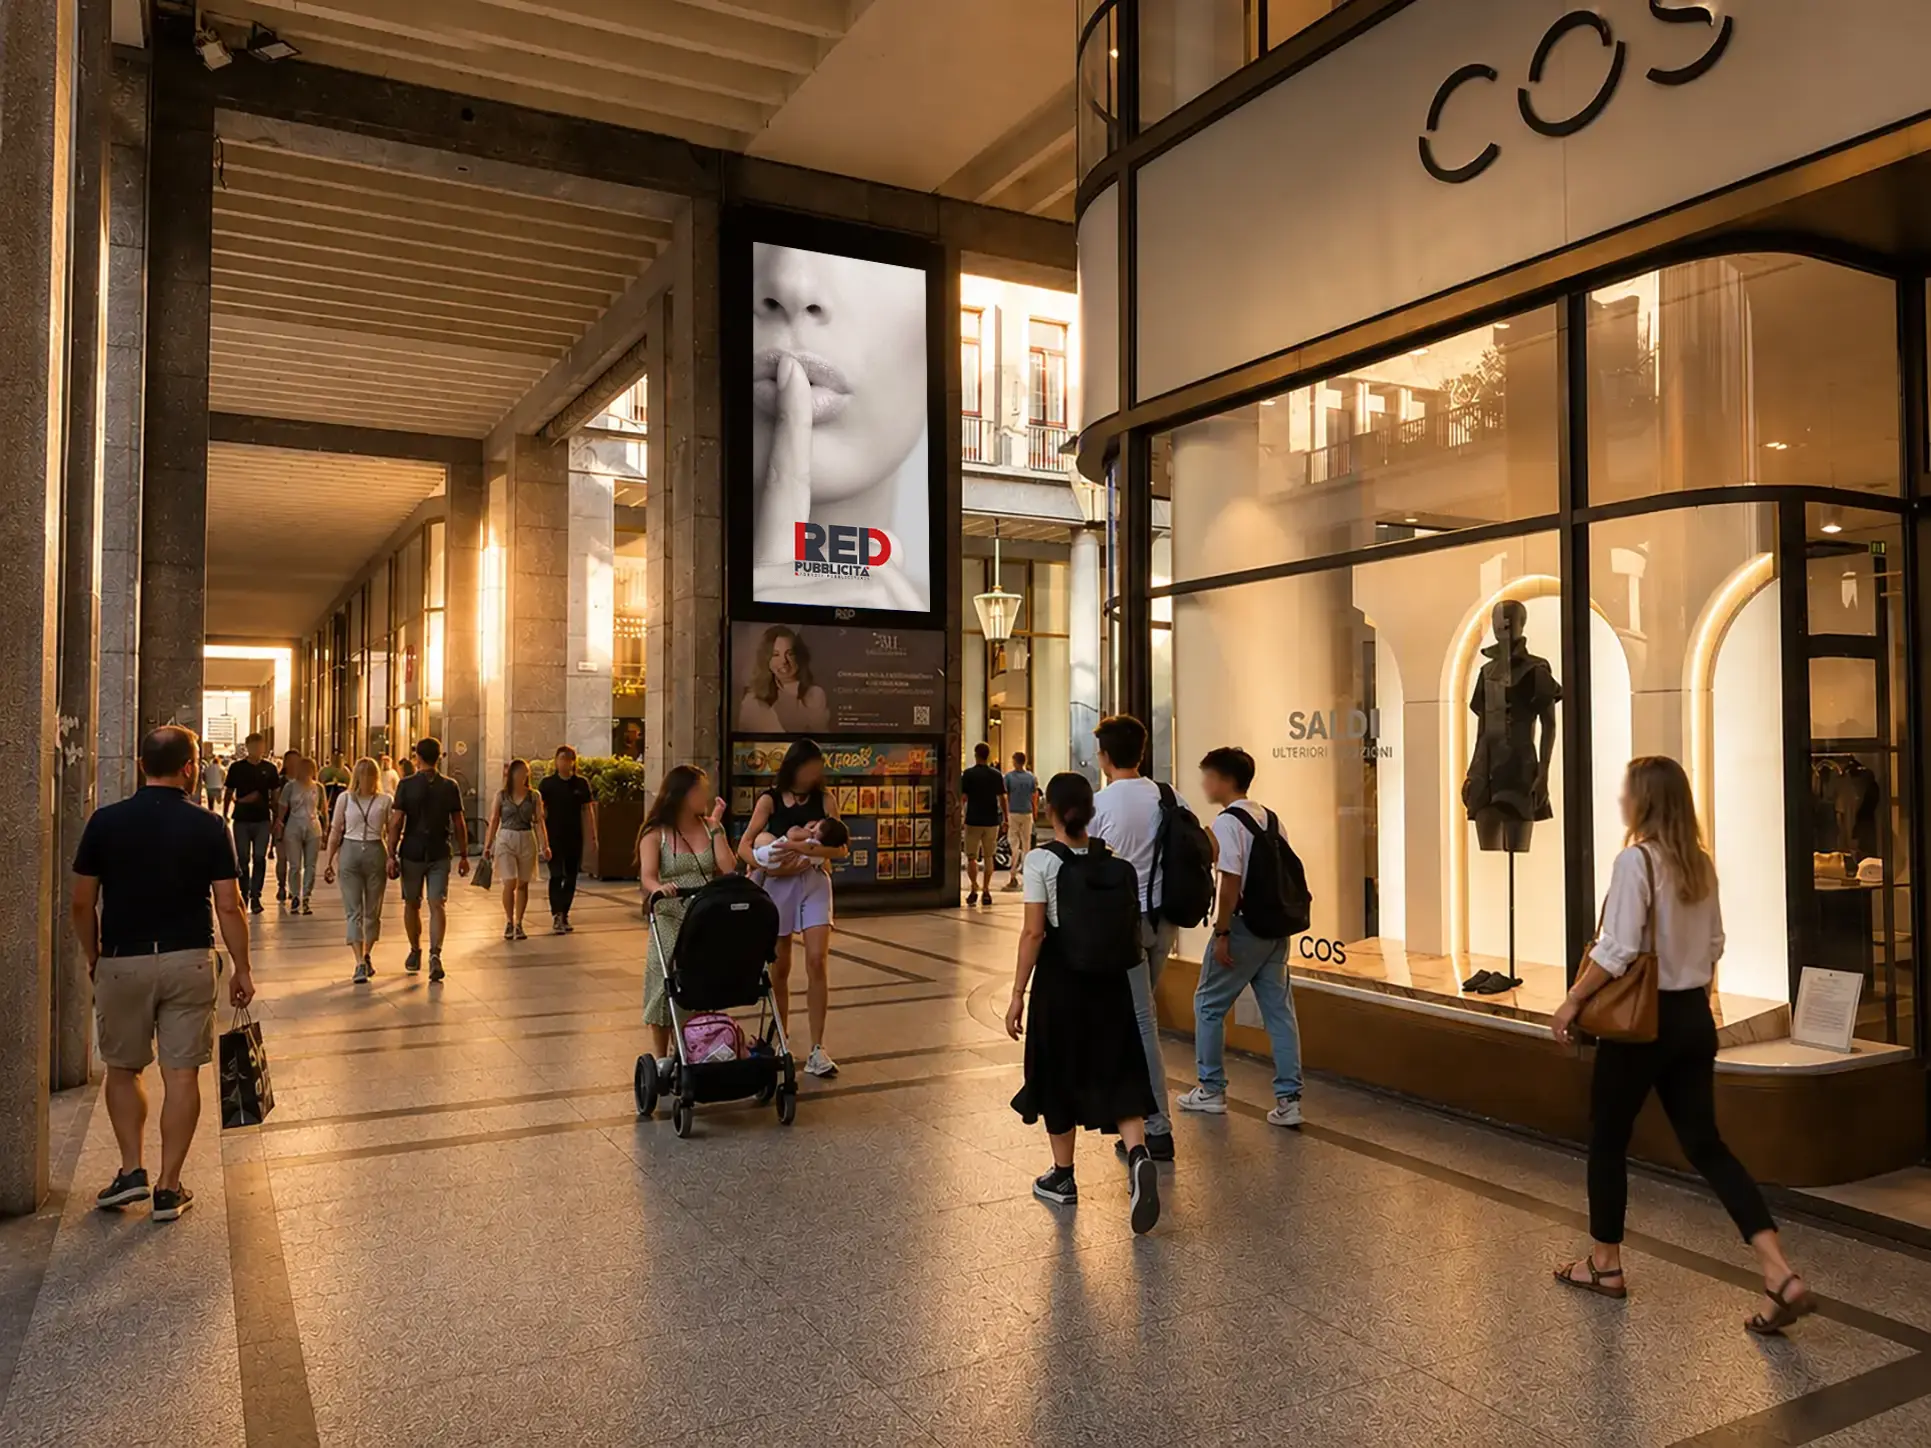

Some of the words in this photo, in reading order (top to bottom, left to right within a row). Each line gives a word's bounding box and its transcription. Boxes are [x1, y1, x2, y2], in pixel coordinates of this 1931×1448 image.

[1418, 0, 1733, 184] COS
[795, 522, 892, 566] RED
[1289, 708, 1380, 740] SALDI
[1272, 746, 1328, 758] ULTERIORI
[1300, 935, 1346, 965] COS
